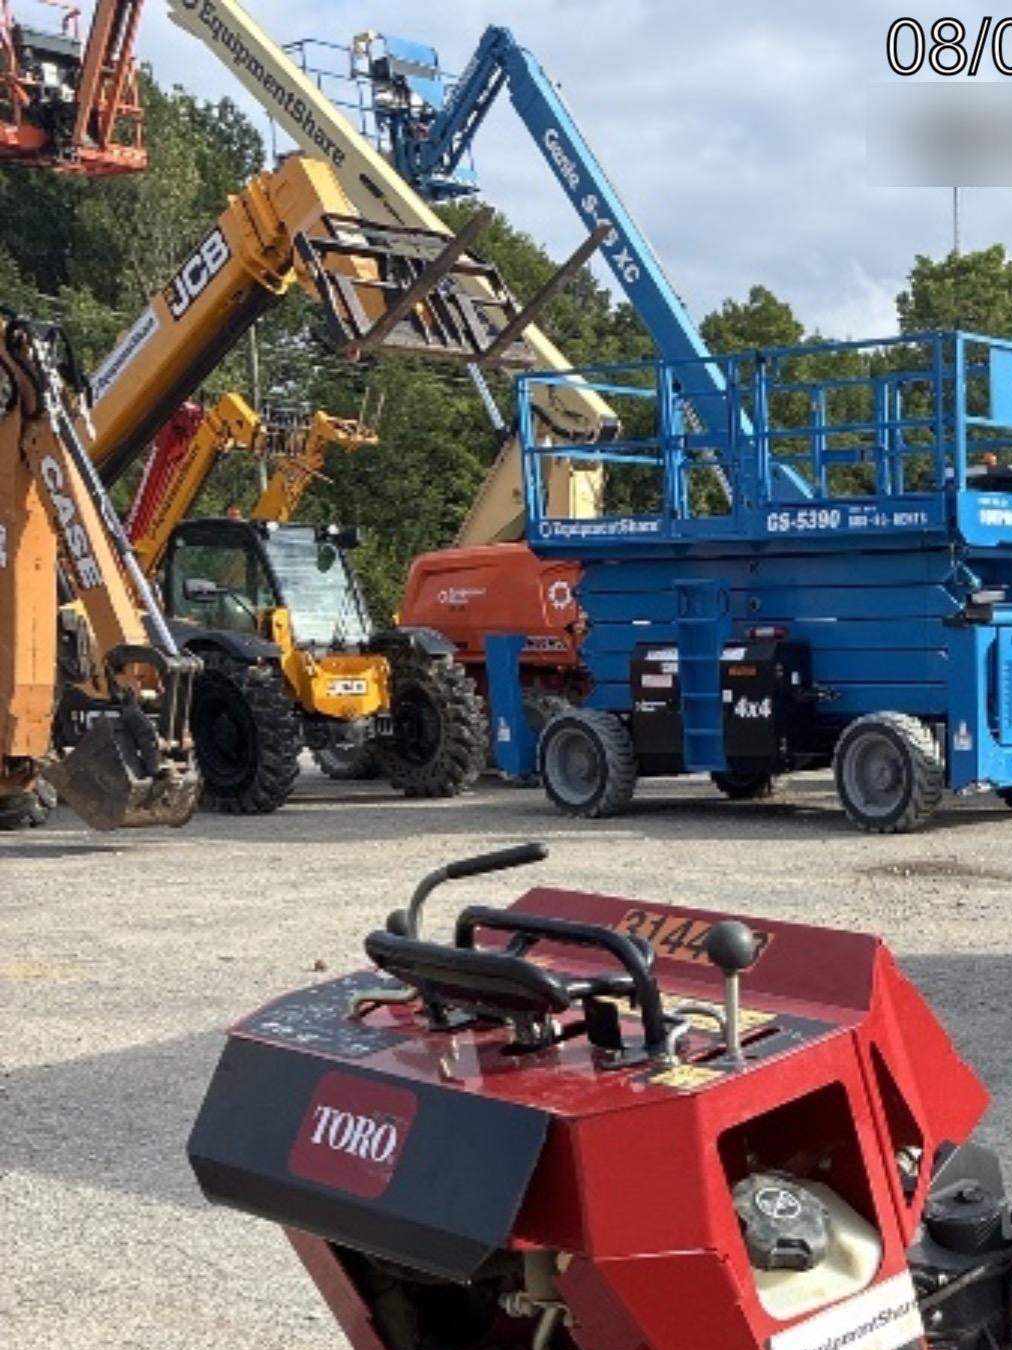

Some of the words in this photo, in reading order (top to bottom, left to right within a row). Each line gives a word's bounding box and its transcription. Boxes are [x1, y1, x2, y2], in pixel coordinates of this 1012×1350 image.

[171, 229, 230, 317] JCB
[612, 248, 640, 283] XC
[41, 456, 104, 589] CASE
[767, 509, 841, 532] GS-5390
[734, 698, 772, 719] 4x4
[311, 1104, 397, 1162] TORO
